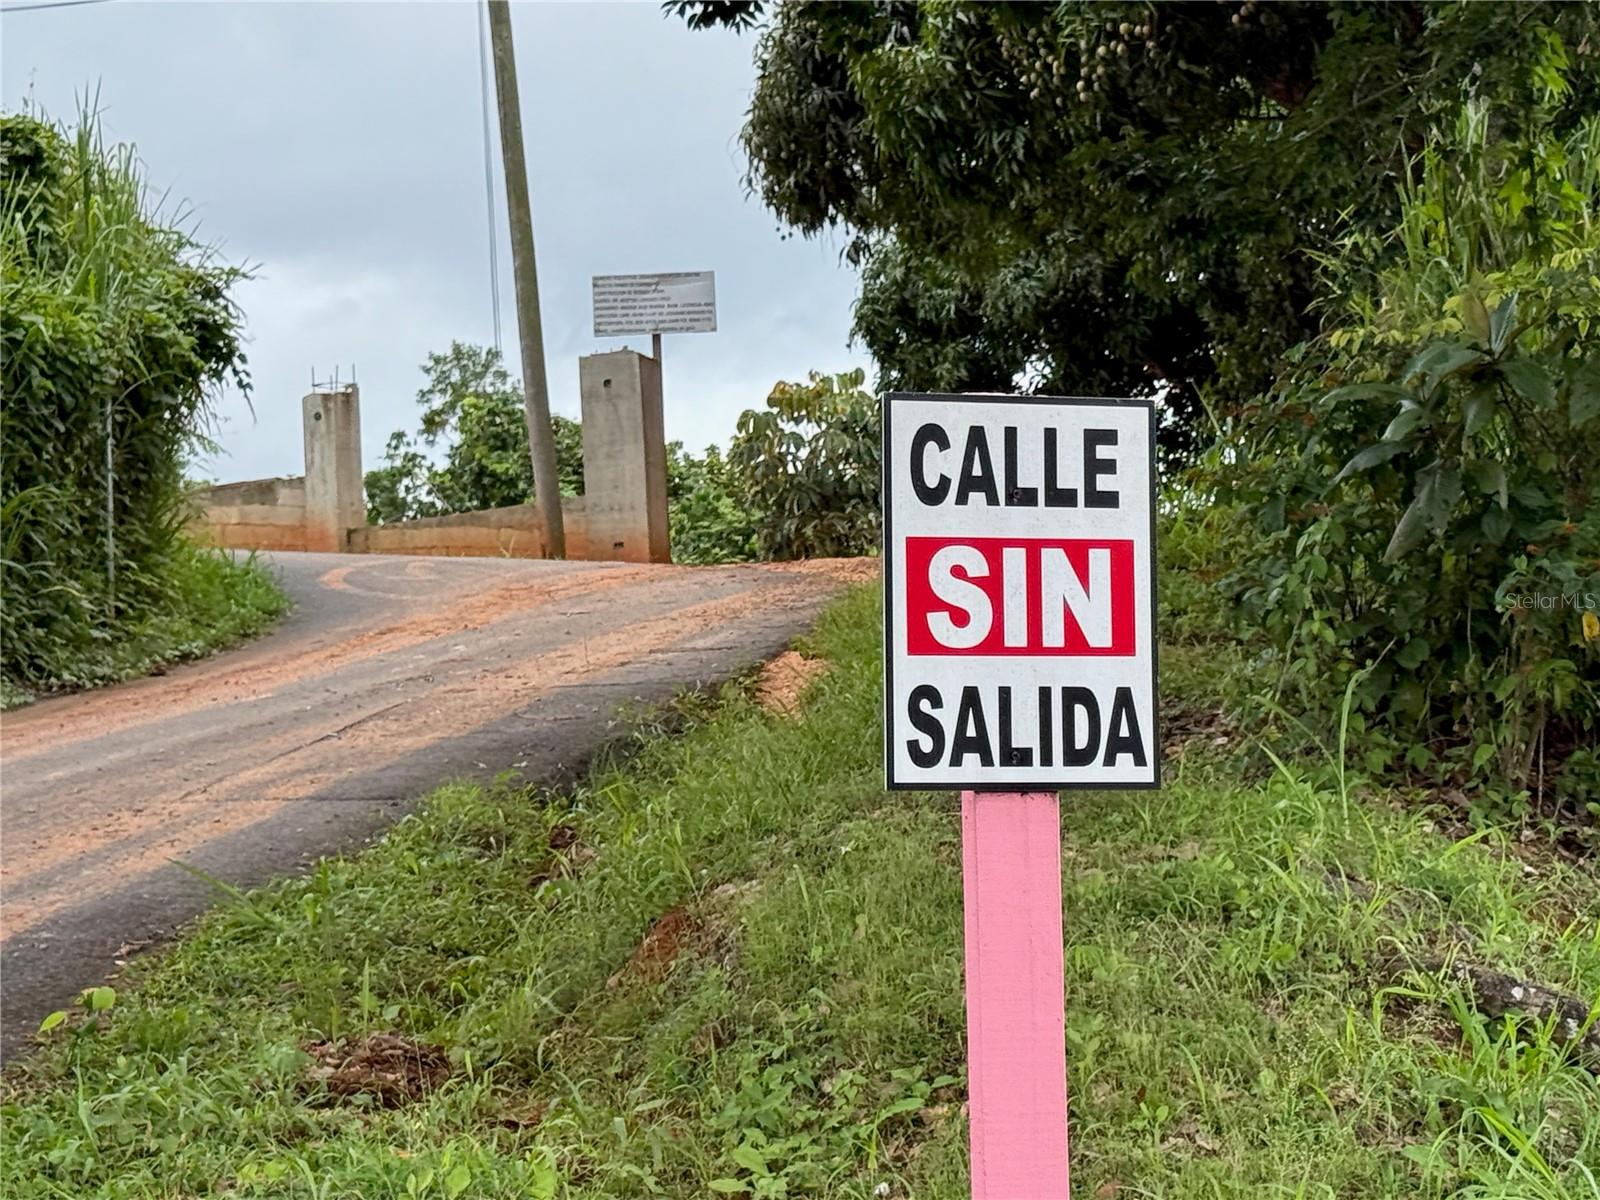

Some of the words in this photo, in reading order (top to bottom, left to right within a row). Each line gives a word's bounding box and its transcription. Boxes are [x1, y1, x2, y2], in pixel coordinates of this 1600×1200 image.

[910, 423, 1120, 509] CALLE
[926, 545, 1113, 649] SIN
[906, 684, 1148, 769] SALIDA
